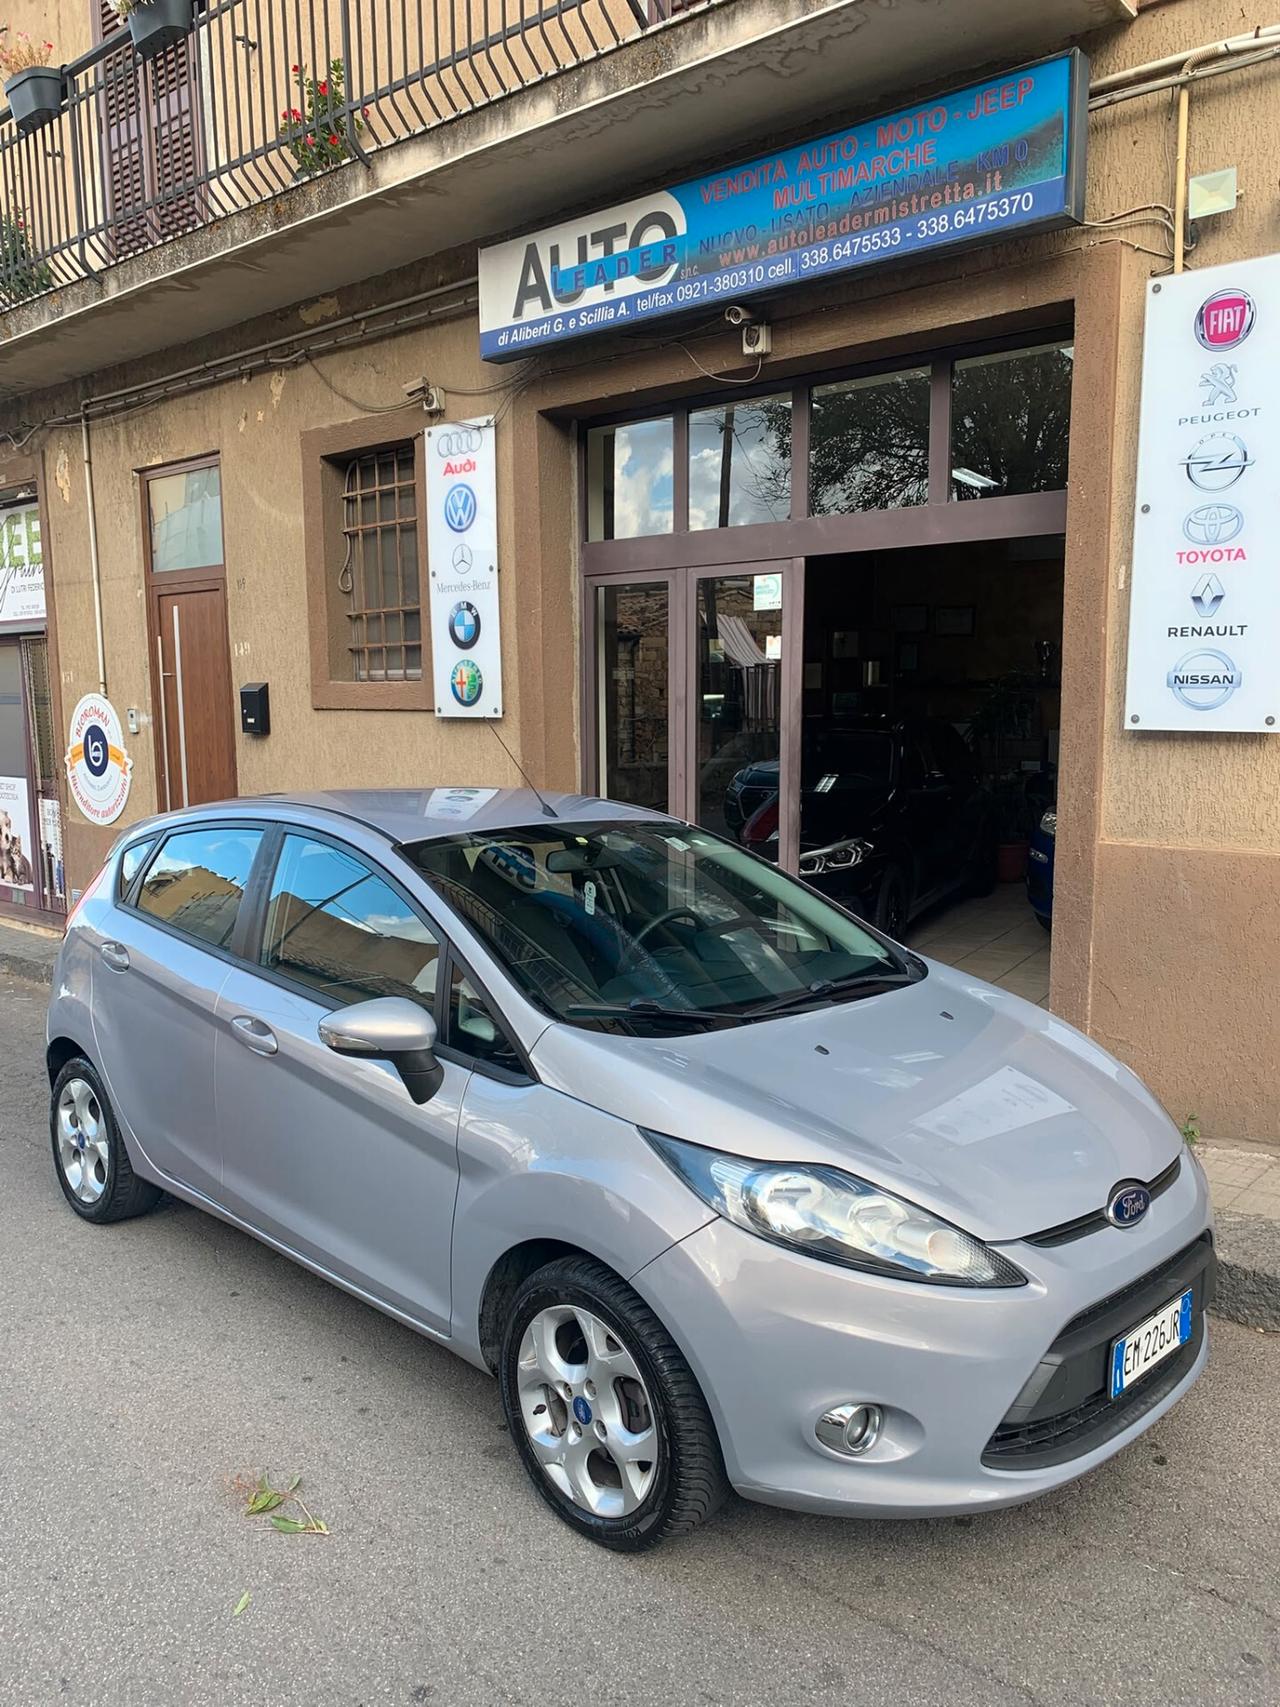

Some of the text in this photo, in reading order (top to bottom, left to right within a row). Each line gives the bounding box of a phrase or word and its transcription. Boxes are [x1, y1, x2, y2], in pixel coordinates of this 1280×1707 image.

[700, 77, 1035, 204] VENDITA AUTO MOTO JEEP
[699, 223, 757, 253] NUOVO
[771, 202, 829, 234] USATO
[850, 160, 960, 209] AZIENDALE
[976, 145, 1011, 174] KM
[773, 138, 938, 210] MULTIMARCHE
[719, 169, 1003, 268] www.autoleadermistretta.it
[497, 191, 1034, 347] di Aliberti G. e Scillia A. tel/fax 0921-380310 cell. 338.6475533 338.6475370
[512, 210, 678, 319] AUTO
[551, 243, 678, 296] LEADER
[1209, 305, 1245, 336] FIAT
[1178, 406, 1262, 427] PEUGEOT
[443, 458, 477, 477] Audi
[1175, 547, 1248, 565] TOYOTA
[1167, 624, 1249, 638] RENAULT
[1173, 674, 1235, 686] NISSAN
[1121, 1192, 1147, 1220] Ford
[1123, 1335, 1142, 1377] EM
[1143, 1308, 1181, 1363] 226JR
